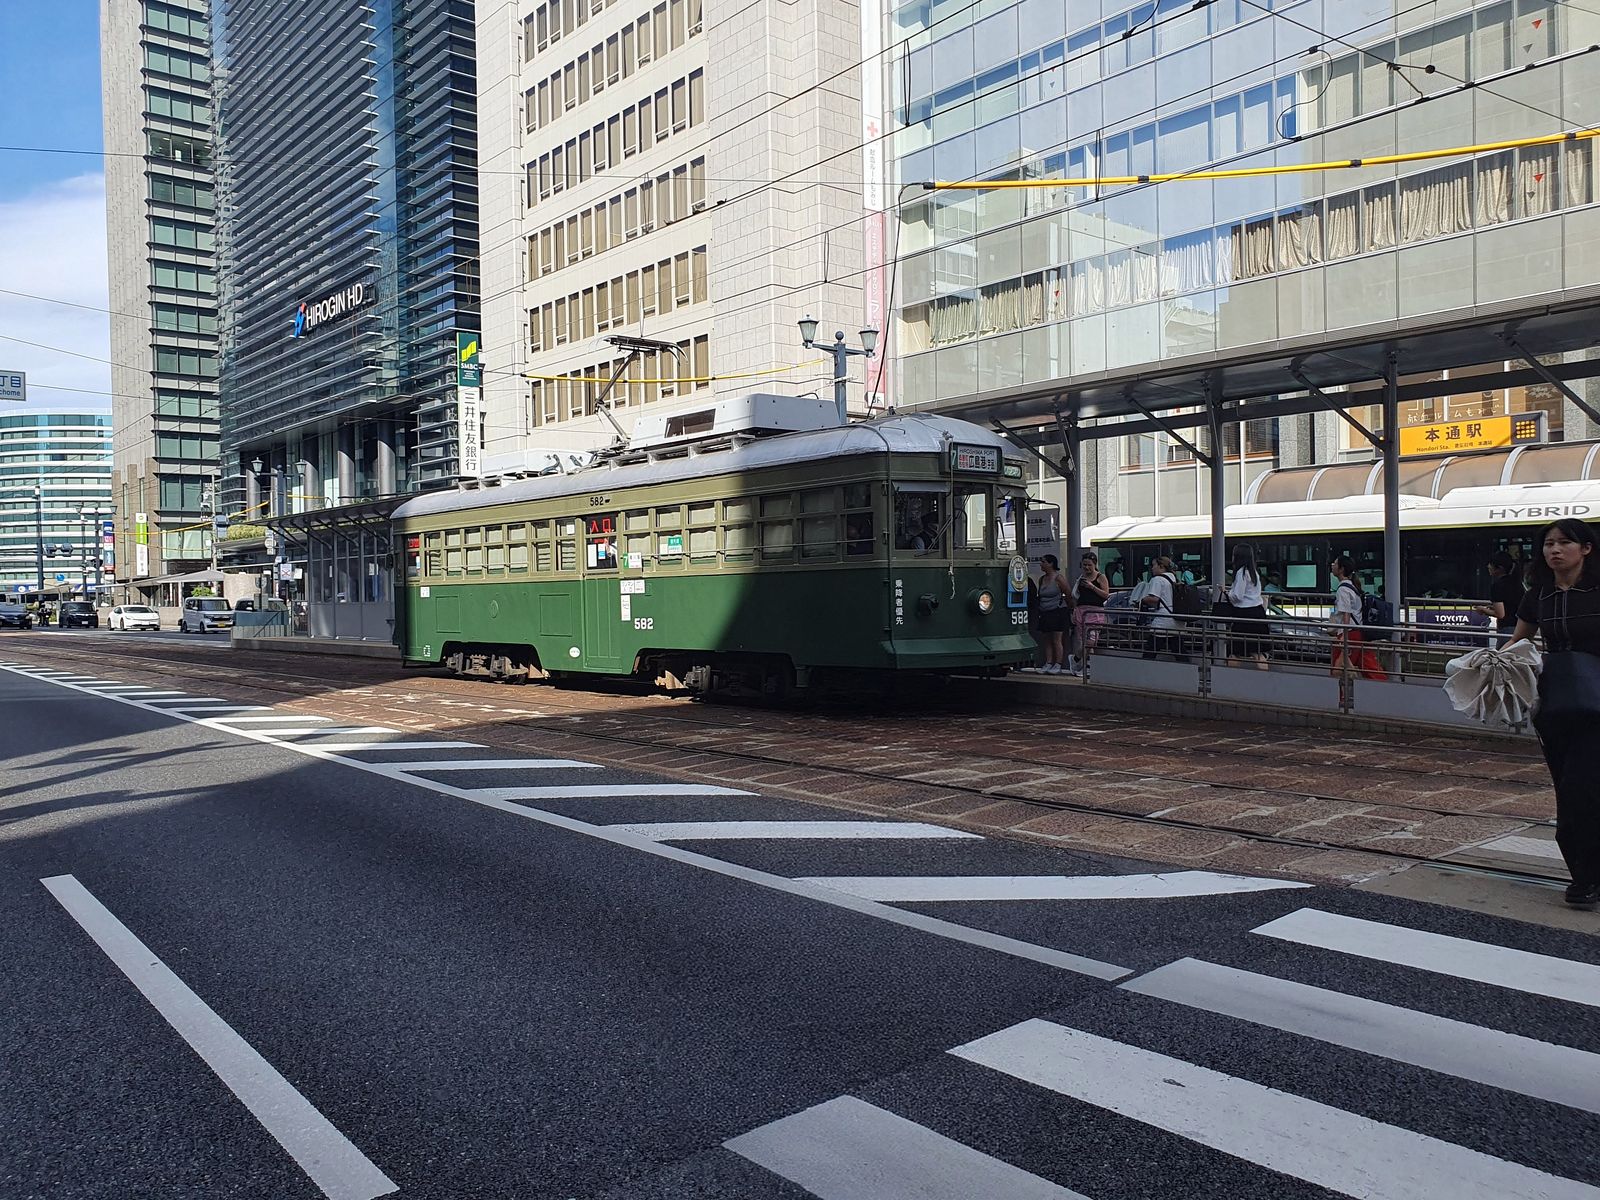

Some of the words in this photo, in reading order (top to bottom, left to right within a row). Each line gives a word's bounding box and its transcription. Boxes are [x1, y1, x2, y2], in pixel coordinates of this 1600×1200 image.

[306, 290, 345, 328] HIROGIN
[348, 283, 363, 308] HD
[464, 392, 477, 471] 三井住友銀行
[1424, 423, 1482, 442] 本通駅
[590, 496, 604, 506] 582
[1489, 505, 1591, 519] HYBRID
[623, 556, 628, 567] 7
[634, 618, 654, 630] 582
[1011, 611, 1028, 625] 582
